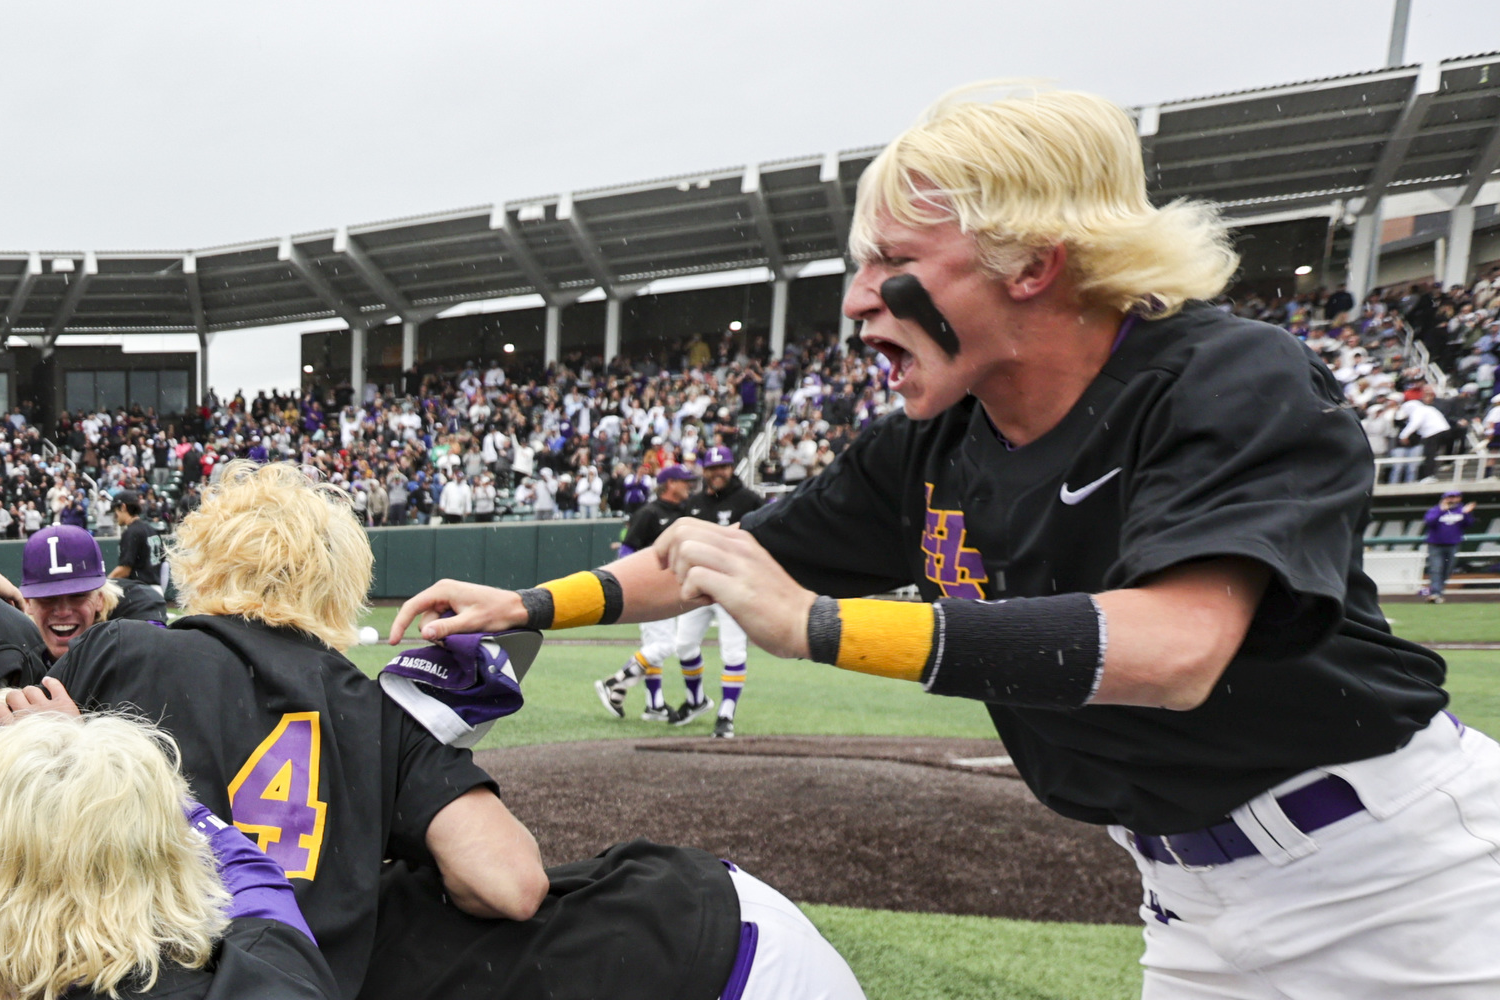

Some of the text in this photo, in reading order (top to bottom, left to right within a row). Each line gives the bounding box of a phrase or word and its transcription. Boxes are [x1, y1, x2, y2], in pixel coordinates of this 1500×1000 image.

[47, 536, 73, 575] L
[399, 656, 449, 680] BASEBALL
[227, 711, 328, 881] 4
